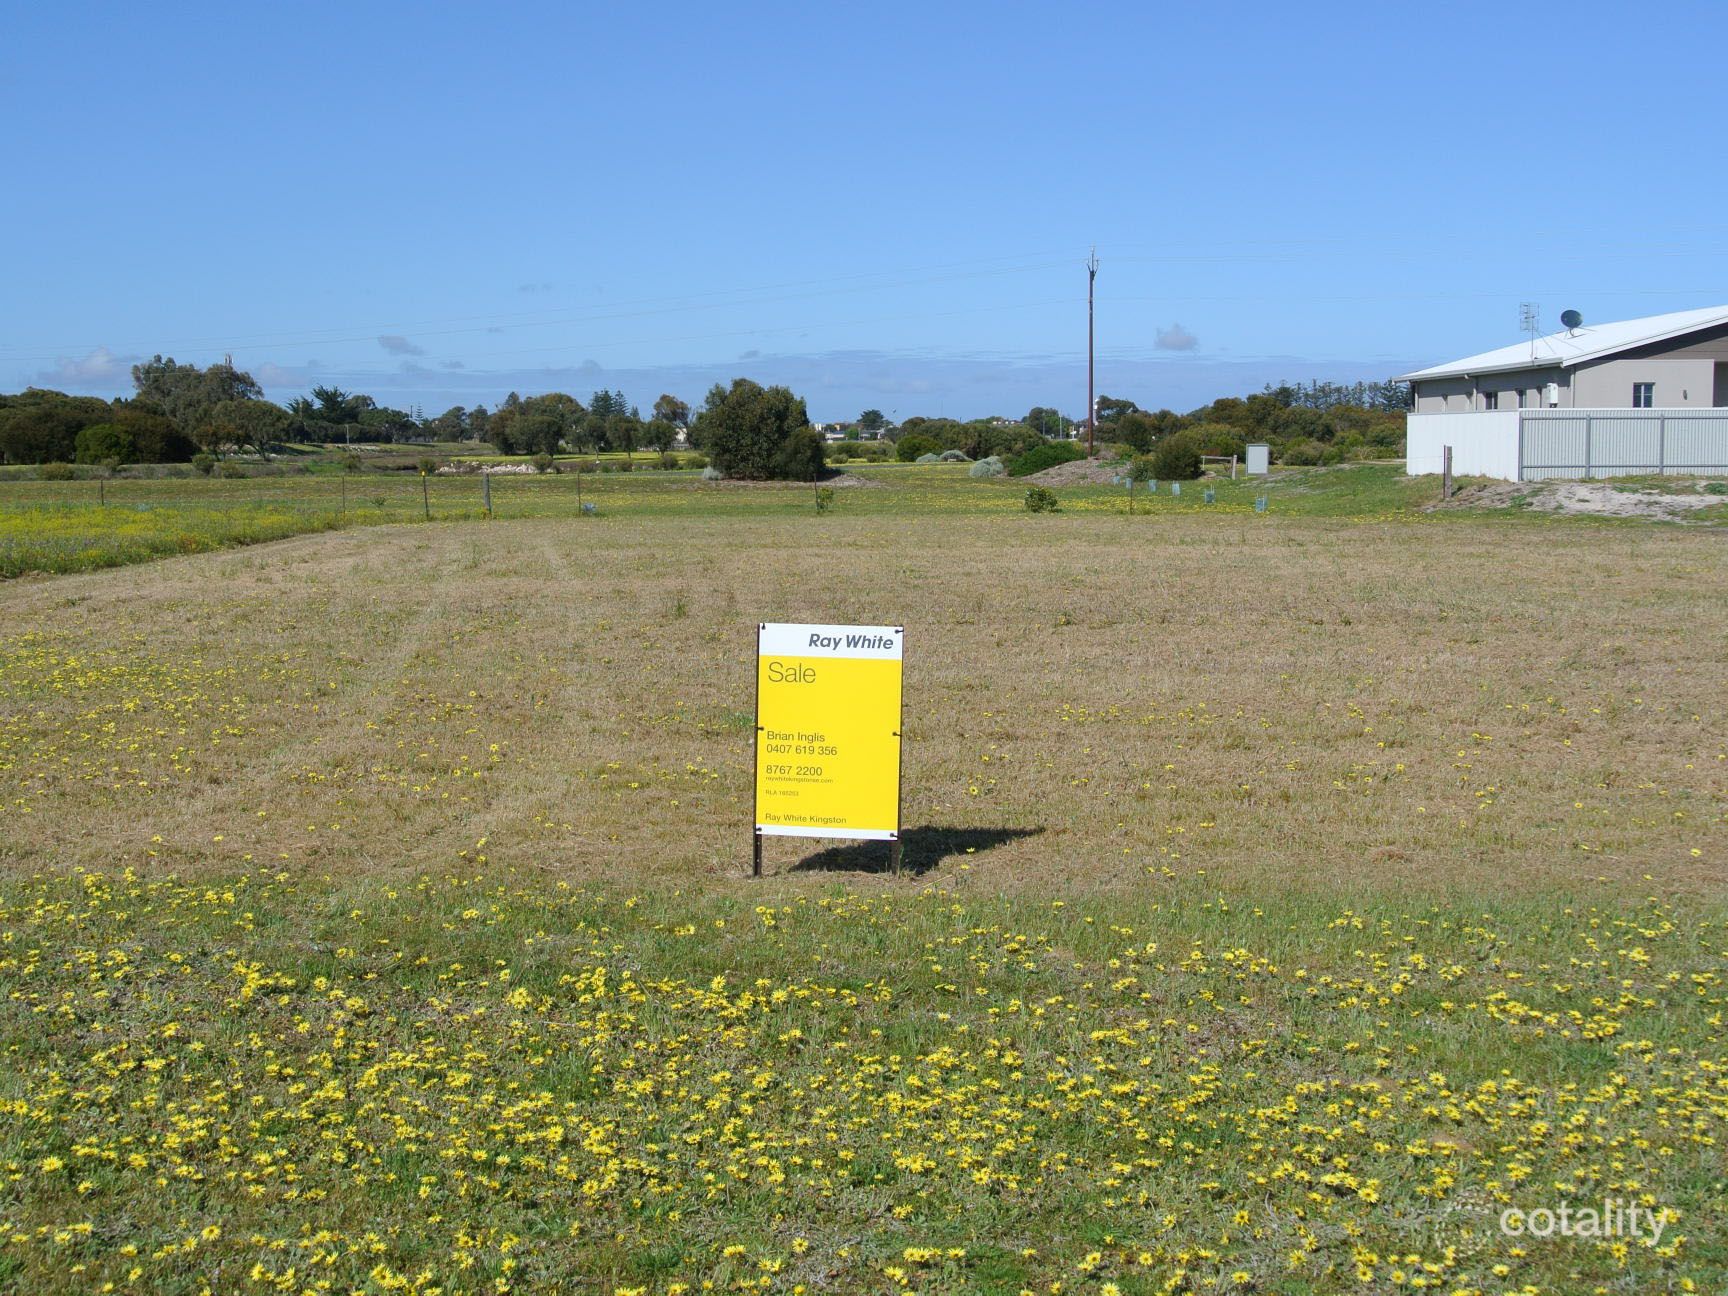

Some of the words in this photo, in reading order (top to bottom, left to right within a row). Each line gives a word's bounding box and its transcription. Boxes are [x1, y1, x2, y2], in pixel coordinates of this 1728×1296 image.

[809, 633, 842, 650] Ray
[846, 635, 893, 649] White
[768, 662, 816, 683] Sale
[767, 731, 794, 741] Brian
[798, 732, 825, 743] Inglis
[766, 744, 792, 754] 0407
[795, 745, 815, 755] 619
[818, 746, 837, 755] 356
[766, 765, 792, 774] 8767
[796, 766, 823, 776] 2200
[766, 813, 781, 822] Ray
[783, 814, 807, 822] White
[809, 815, 847, 825] Kingston
